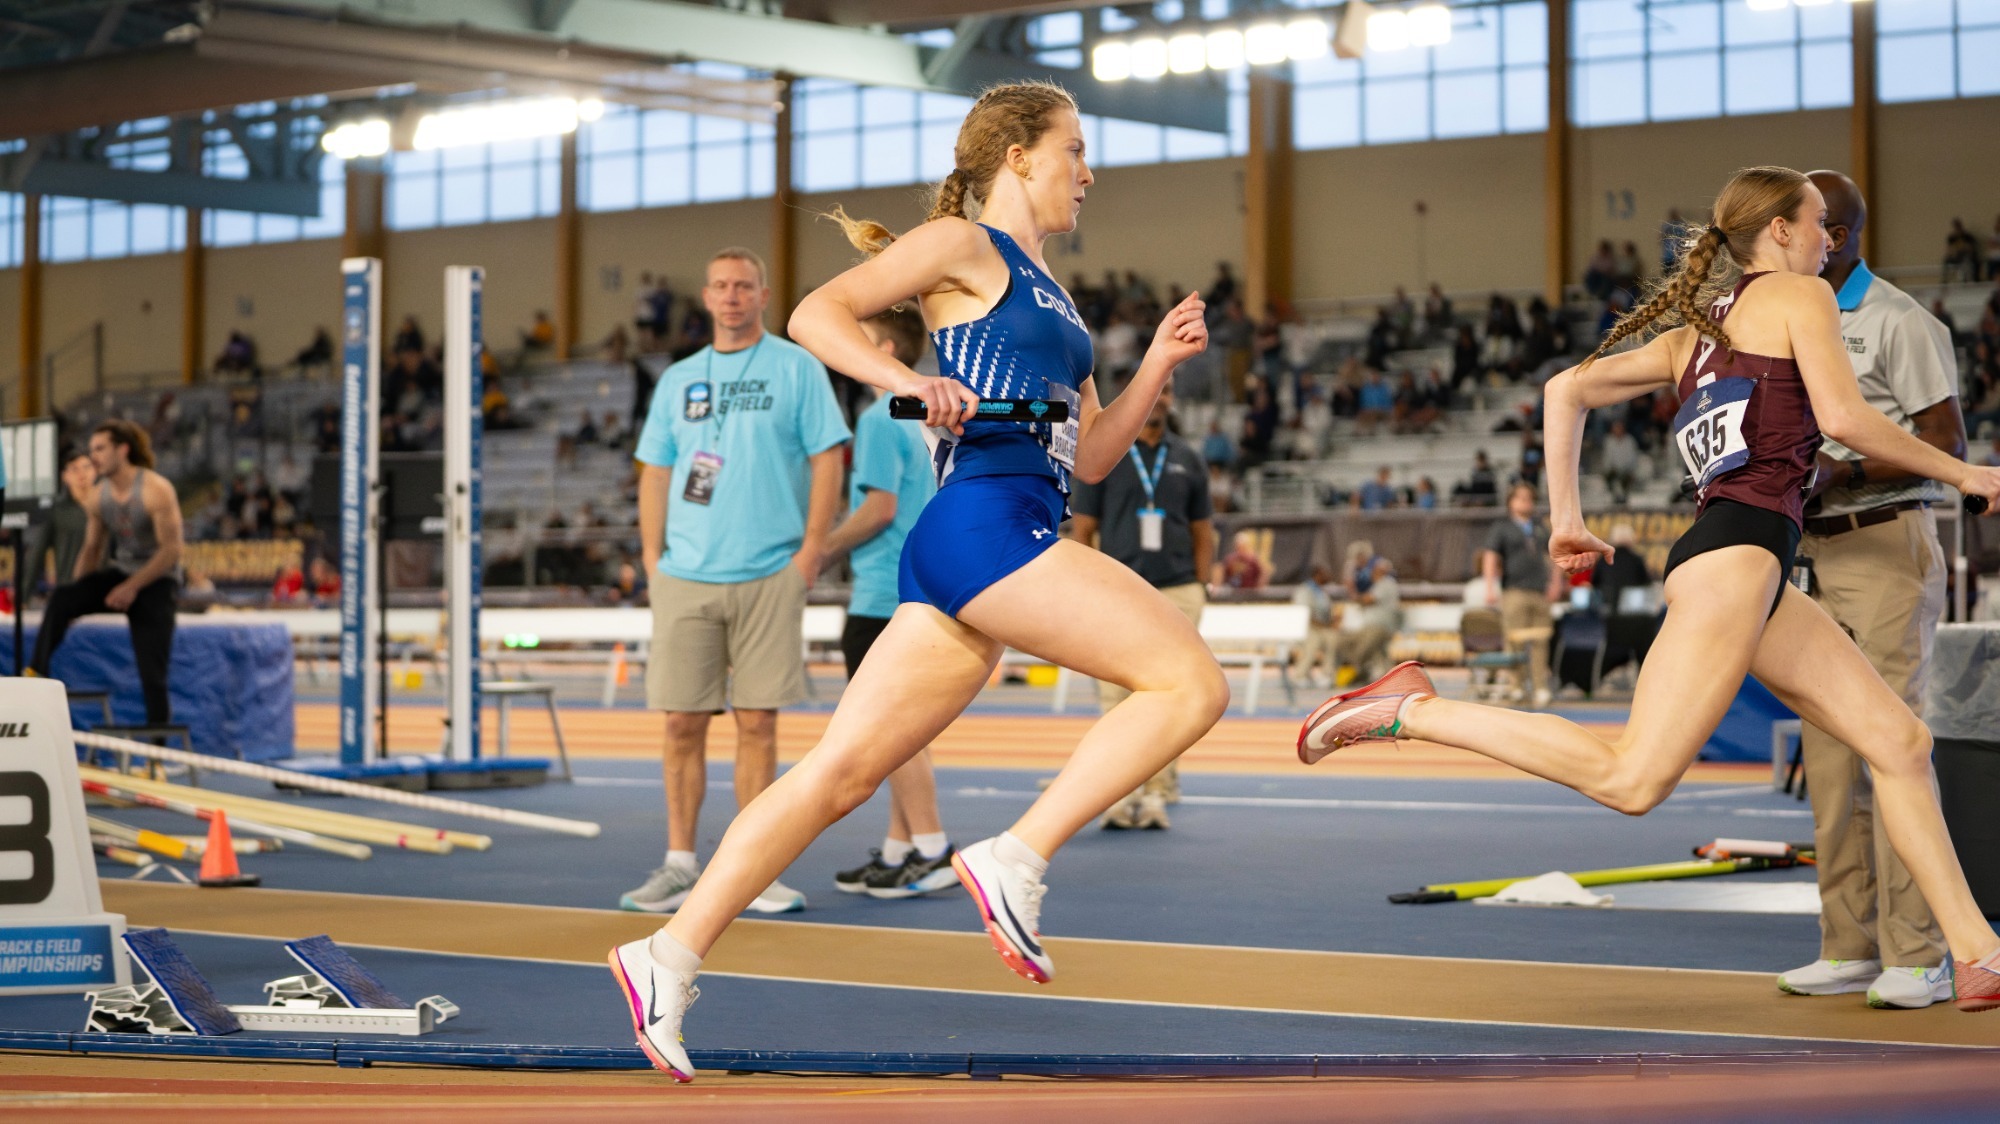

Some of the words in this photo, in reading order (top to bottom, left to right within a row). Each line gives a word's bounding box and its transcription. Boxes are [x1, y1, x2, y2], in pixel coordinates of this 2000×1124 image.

[1032, 286, 1090, 335] COLB
[720, 378, 770, 397] TRACK
[732, 395, 775, 412] FIELD
[1685, 409, 1729, 474] 635
[0, 723, 30, 738] ILL
[0, 940, 33, 955] RACK
[35, 940, 44, 954] &
[47, 938, 82, 954] FIELD
[0, 954, 104, 974] MPIONSHIPS
